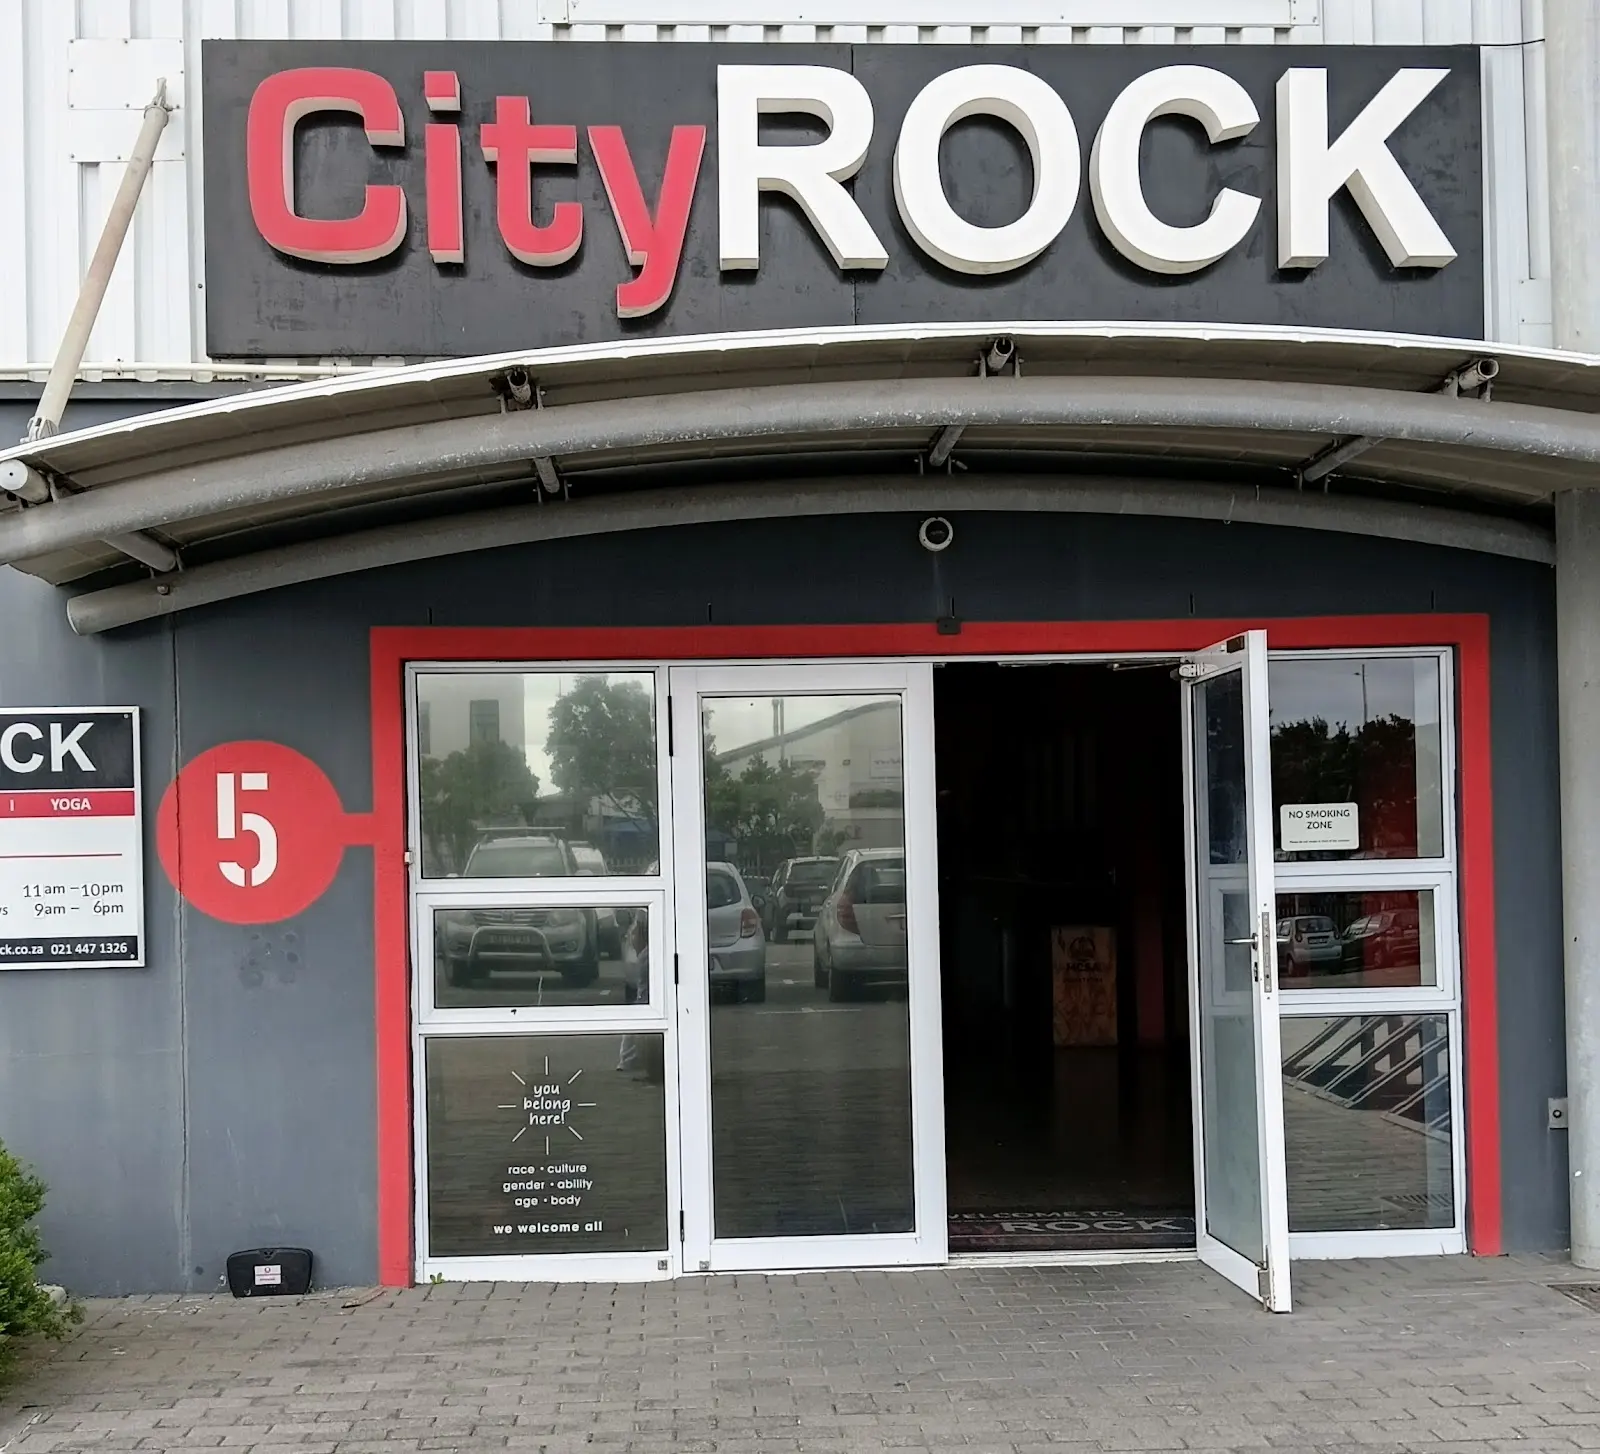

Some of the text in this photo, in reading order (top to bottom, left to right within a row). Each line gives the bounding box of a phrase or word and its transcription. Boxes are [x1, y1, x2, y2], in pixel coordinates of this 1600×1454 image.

[247, 64, 1458, 319] CityROCK
[50, 798, 92, 811] YOGA
[1288, 809, 1350, 819] NO SMOKING
[216, 772, 278, 888] 5
[1306, 821, 1333, 830] ZONE
[22, 884, 65, 898] 11am
[34, 903, 66, 916] 9am
[93, 901, 124, 916] 6pm
[50, 943, 72, 955] 021
[74, 943, 97, 954] 447
[99, 942, 128, 954] 1326
[533, 1084, 560, 1098] you
[523, 1096, 571, 1113] belong
[529, 1111, 565, 1125] here!
[508, 1163, 587, 1175] race culture
[503, 1178, 593, 1193] gender ability
[515, 1195, 581, 1208] age body
[1084, 1209, 1125, 1218] TO
[493, 1220, 603, 1234] we welcome all
